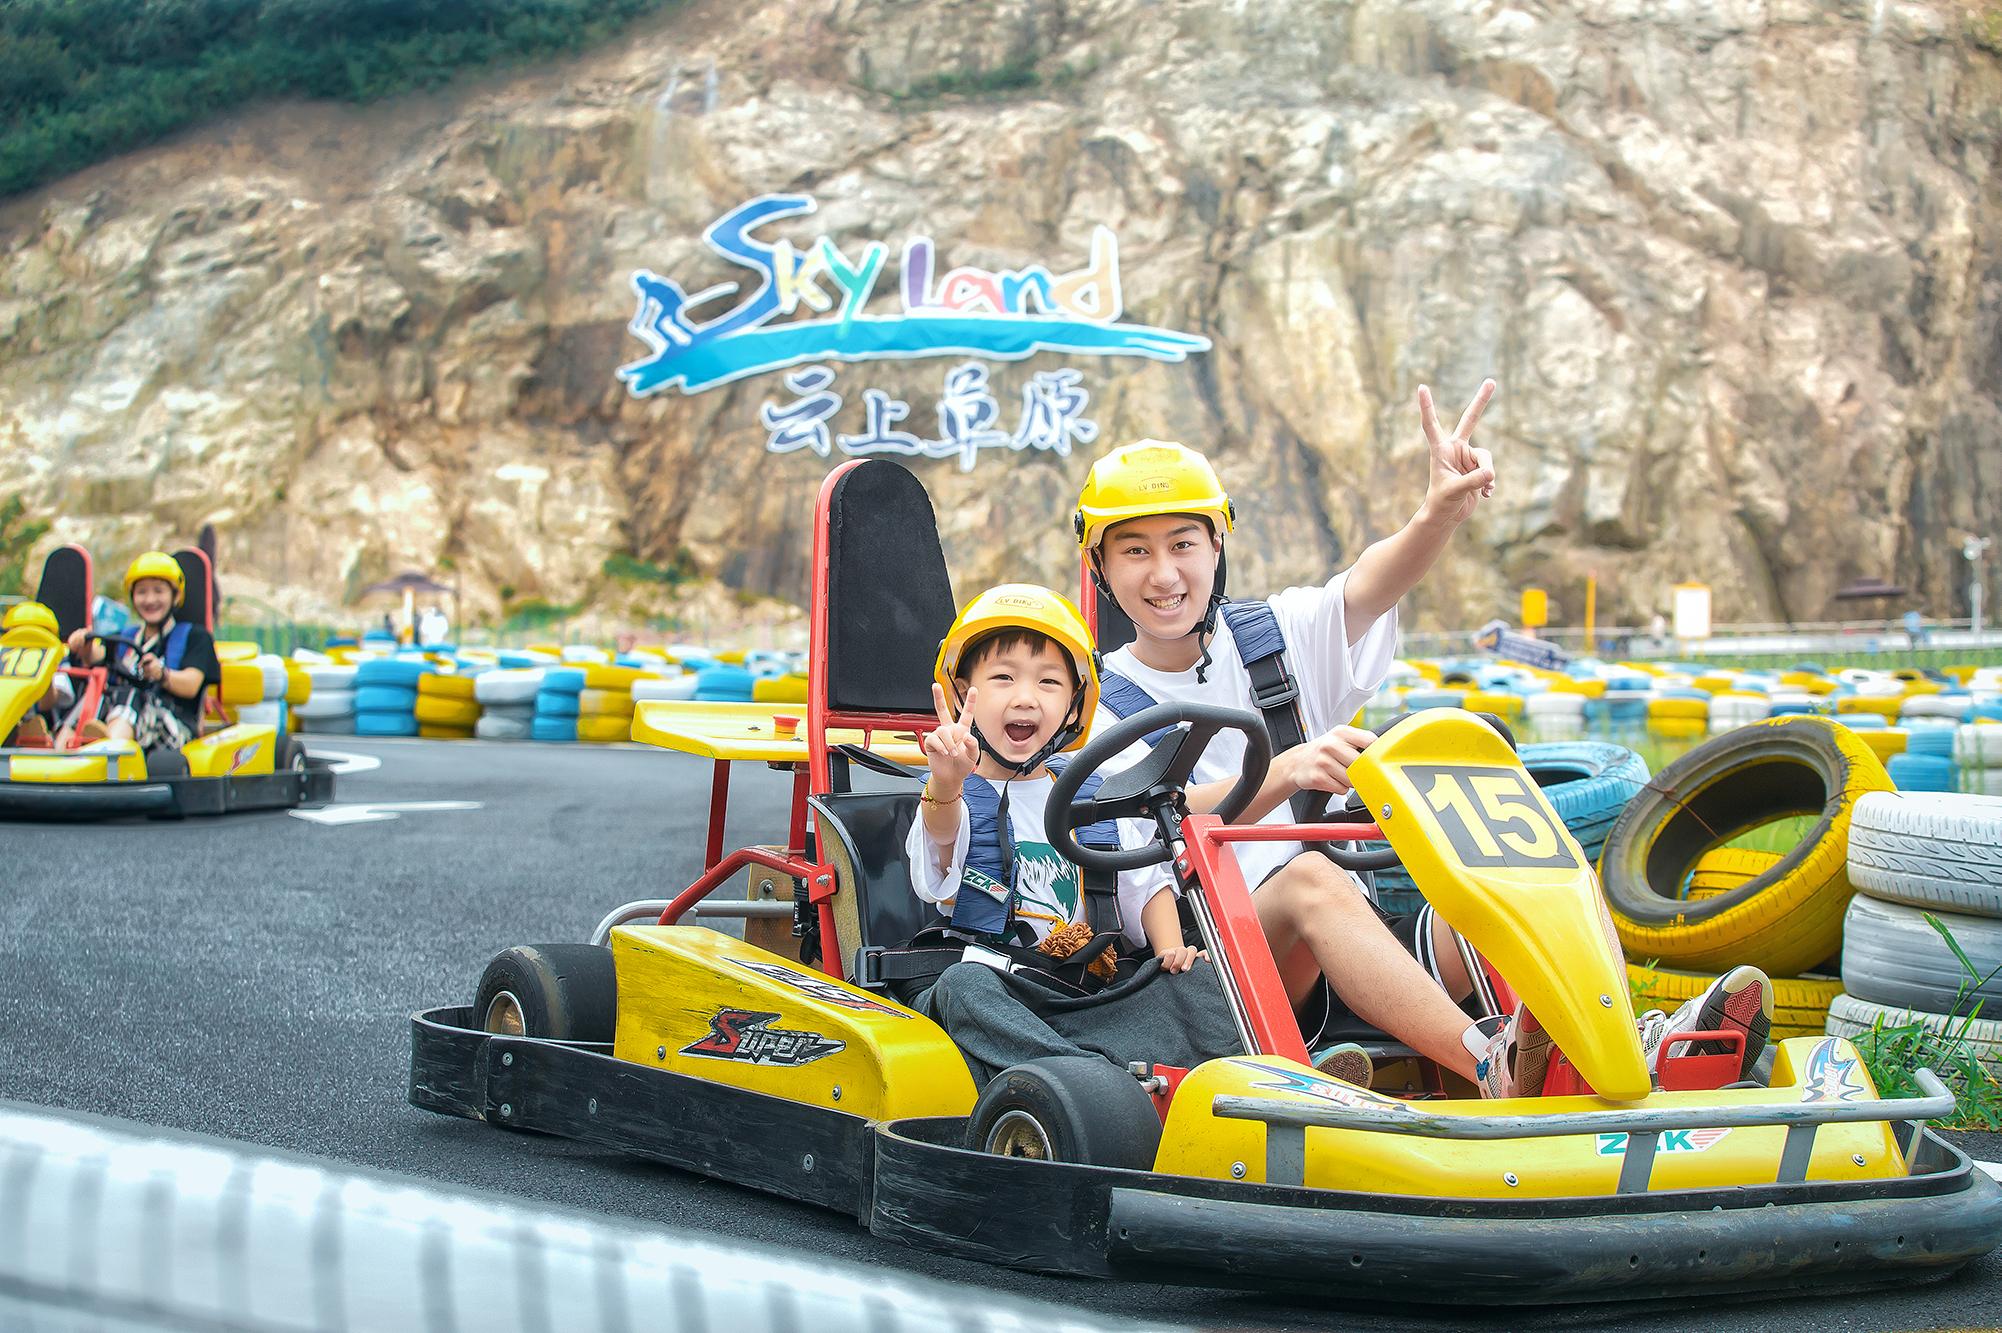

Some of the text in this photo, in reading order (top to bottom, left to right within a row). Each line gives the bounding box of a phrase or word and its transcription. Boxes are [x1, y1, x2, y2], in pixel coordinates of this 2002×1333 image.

[1425, 773, 1560, 859] 15
[963, 870, 996, 890] ZCK
[1599, 1130, 1694, 1155] ZK
